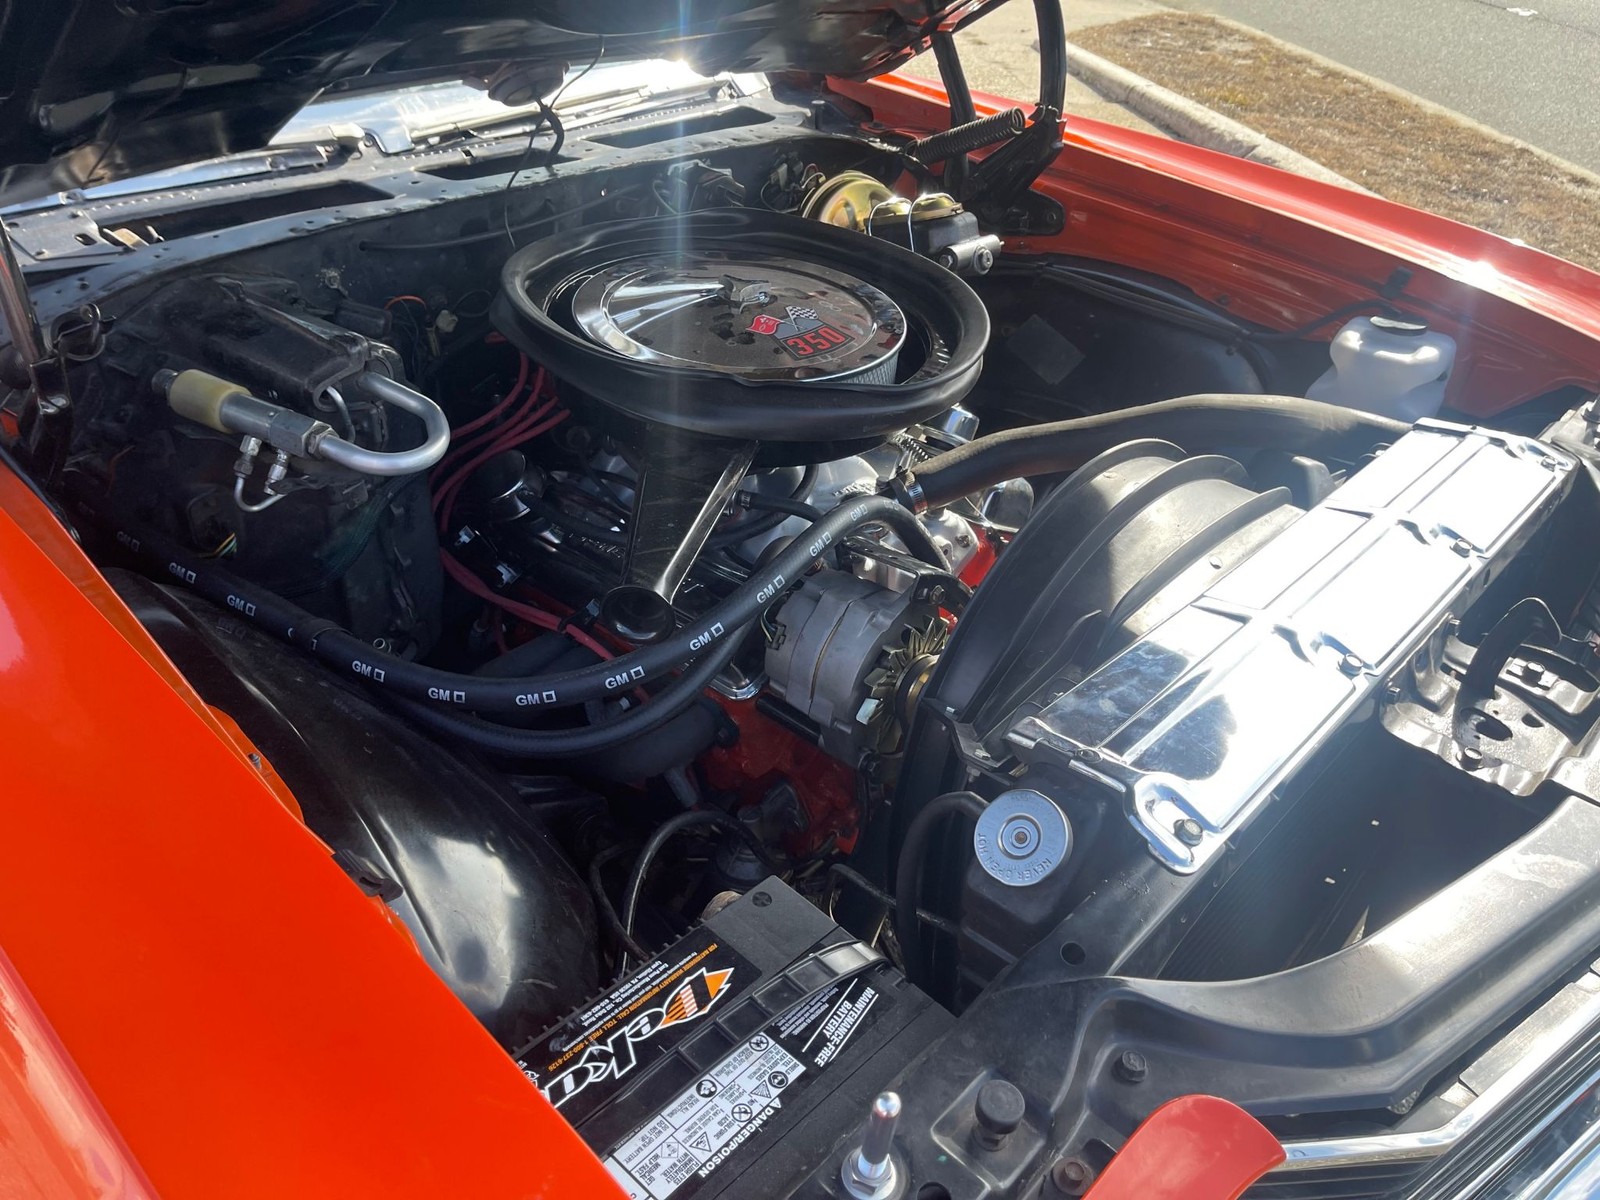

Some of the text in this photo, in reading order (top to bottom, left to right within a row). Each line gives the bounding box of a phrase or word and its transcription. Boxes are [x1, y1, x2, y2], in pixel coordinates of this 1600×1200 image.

[787, 327, 846, 354] 350
[809, 536, 825, 557] GM
[169, 562, 185, 578] GM
[756, 584, 776, 604] GM
[226, 594, 246, 612] GM
[689, 632, 712, 651] GM
[352, 660, 372, 677] GM
[605, 673, 629, 690] GM
[428, 687, 451, 701] GM
[515, 694, 540, 706] GM
[977, 832, 988, 855] HOT
[983, 856, 1012, 879] OPEN
[1016, 857, 1053, 880] NEVER
[657, 968, 684, 989] WARRANTY
[601, 1018, 617, 1030] TOLL
[814, 986, 875, 1067] MAINTENANCE-FREE
[821, 999, 852, 1038] BATTERY
[587, 1028, 604, 1041] FREE
[755, 1052, 788, 1081] EXPLOSIVE GASES
[784, 1061, 799, 1075] SHIELD
[656, 1119, 664, 1127] DO
[660, 1123, 669, 1131] DO
[712, 1120, 734, 1139] SULFURIC
[716, 1116, 729, 1126] ACID
[647, 1125, 658, 1135] NOT
[652, 1129, 663, 1139] NOT
[641, 1136, 654, 1148] OPEN
[697, 1106, 774, 1177] DANGER/POISON
[646, 1152, 660, 1165] HELP
[675, 1151, 689, 1163] WITH
[639, 1161, 660, 1180] MEDICAL
[663, 1156, 695, 1183] IMMEDIATELY
[672, 1161, 699, 1185] FLUSH EYES
[643, 1175, 656, 1186] GET
